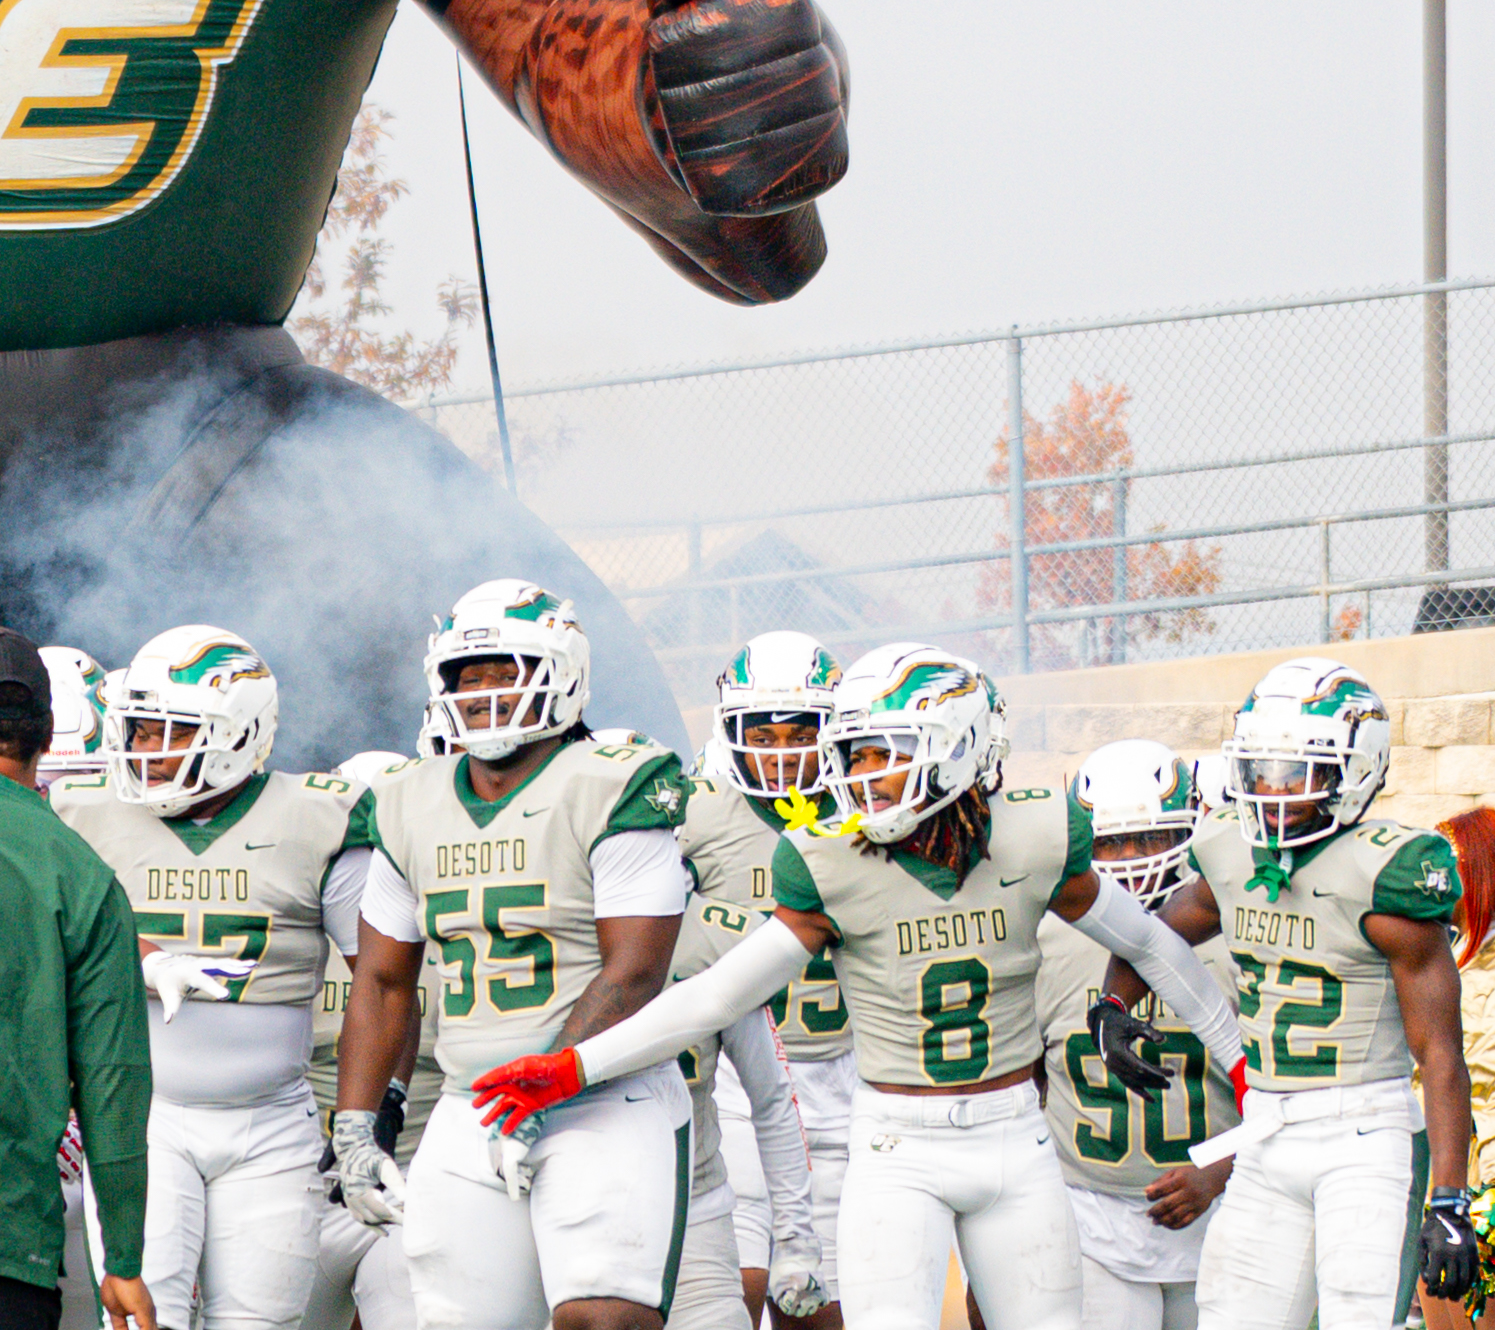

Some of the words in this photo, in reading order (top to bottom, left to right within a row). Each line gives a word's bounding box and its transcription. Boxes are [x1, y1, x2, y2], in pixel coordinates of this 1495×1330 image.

[1003, 787, 1056, 805] 8
[435, 838, 526, 879] DESOTO
[147, 867, 250, 903] DESOTO
[701, 903, 752, 936] 2
[895, 907, 1008, 957] DESOTO
[1233, 905, 1316, 951] DESOTO
[422, 880, 558, 1019] 55
[917, 953, 994, 1088] 8
[1064, 1027, 1210, 1169] 90
